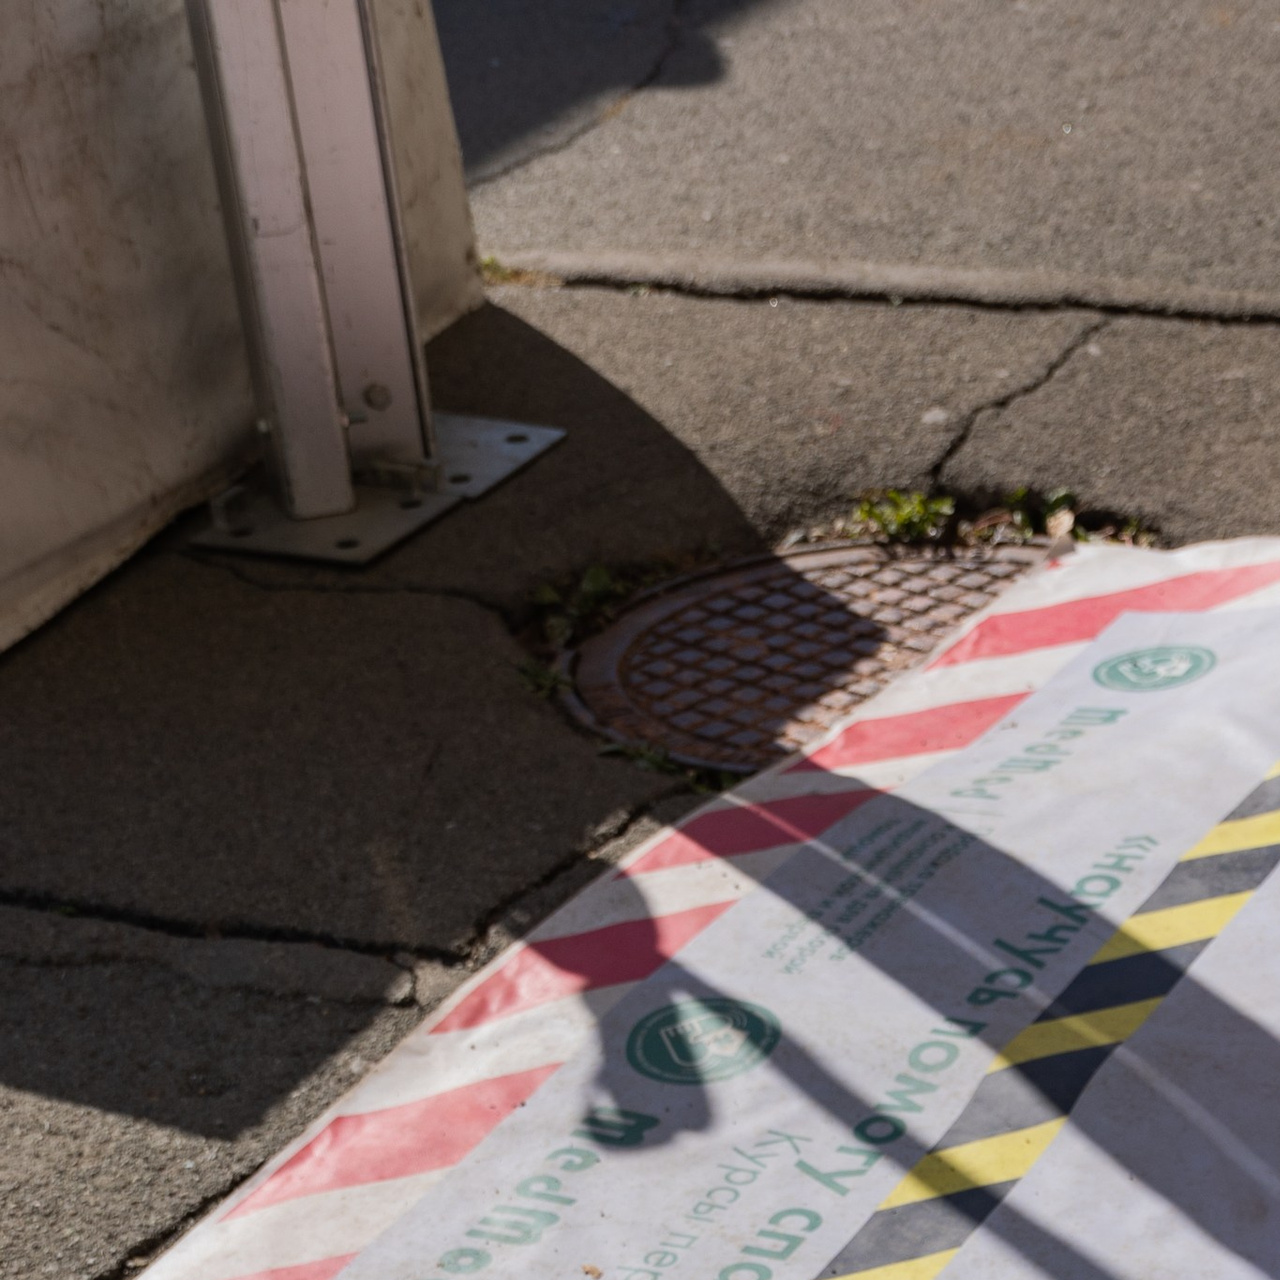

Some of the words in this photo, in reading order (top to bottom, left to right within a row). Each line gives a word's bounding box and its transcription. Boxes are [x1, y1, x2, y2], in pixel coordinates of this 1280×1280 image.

[966, 834, 1159, 1006] «научусь
[684, 1128, 813, 1224] Курсы
[795, 1015, 988, 1197] помогу
